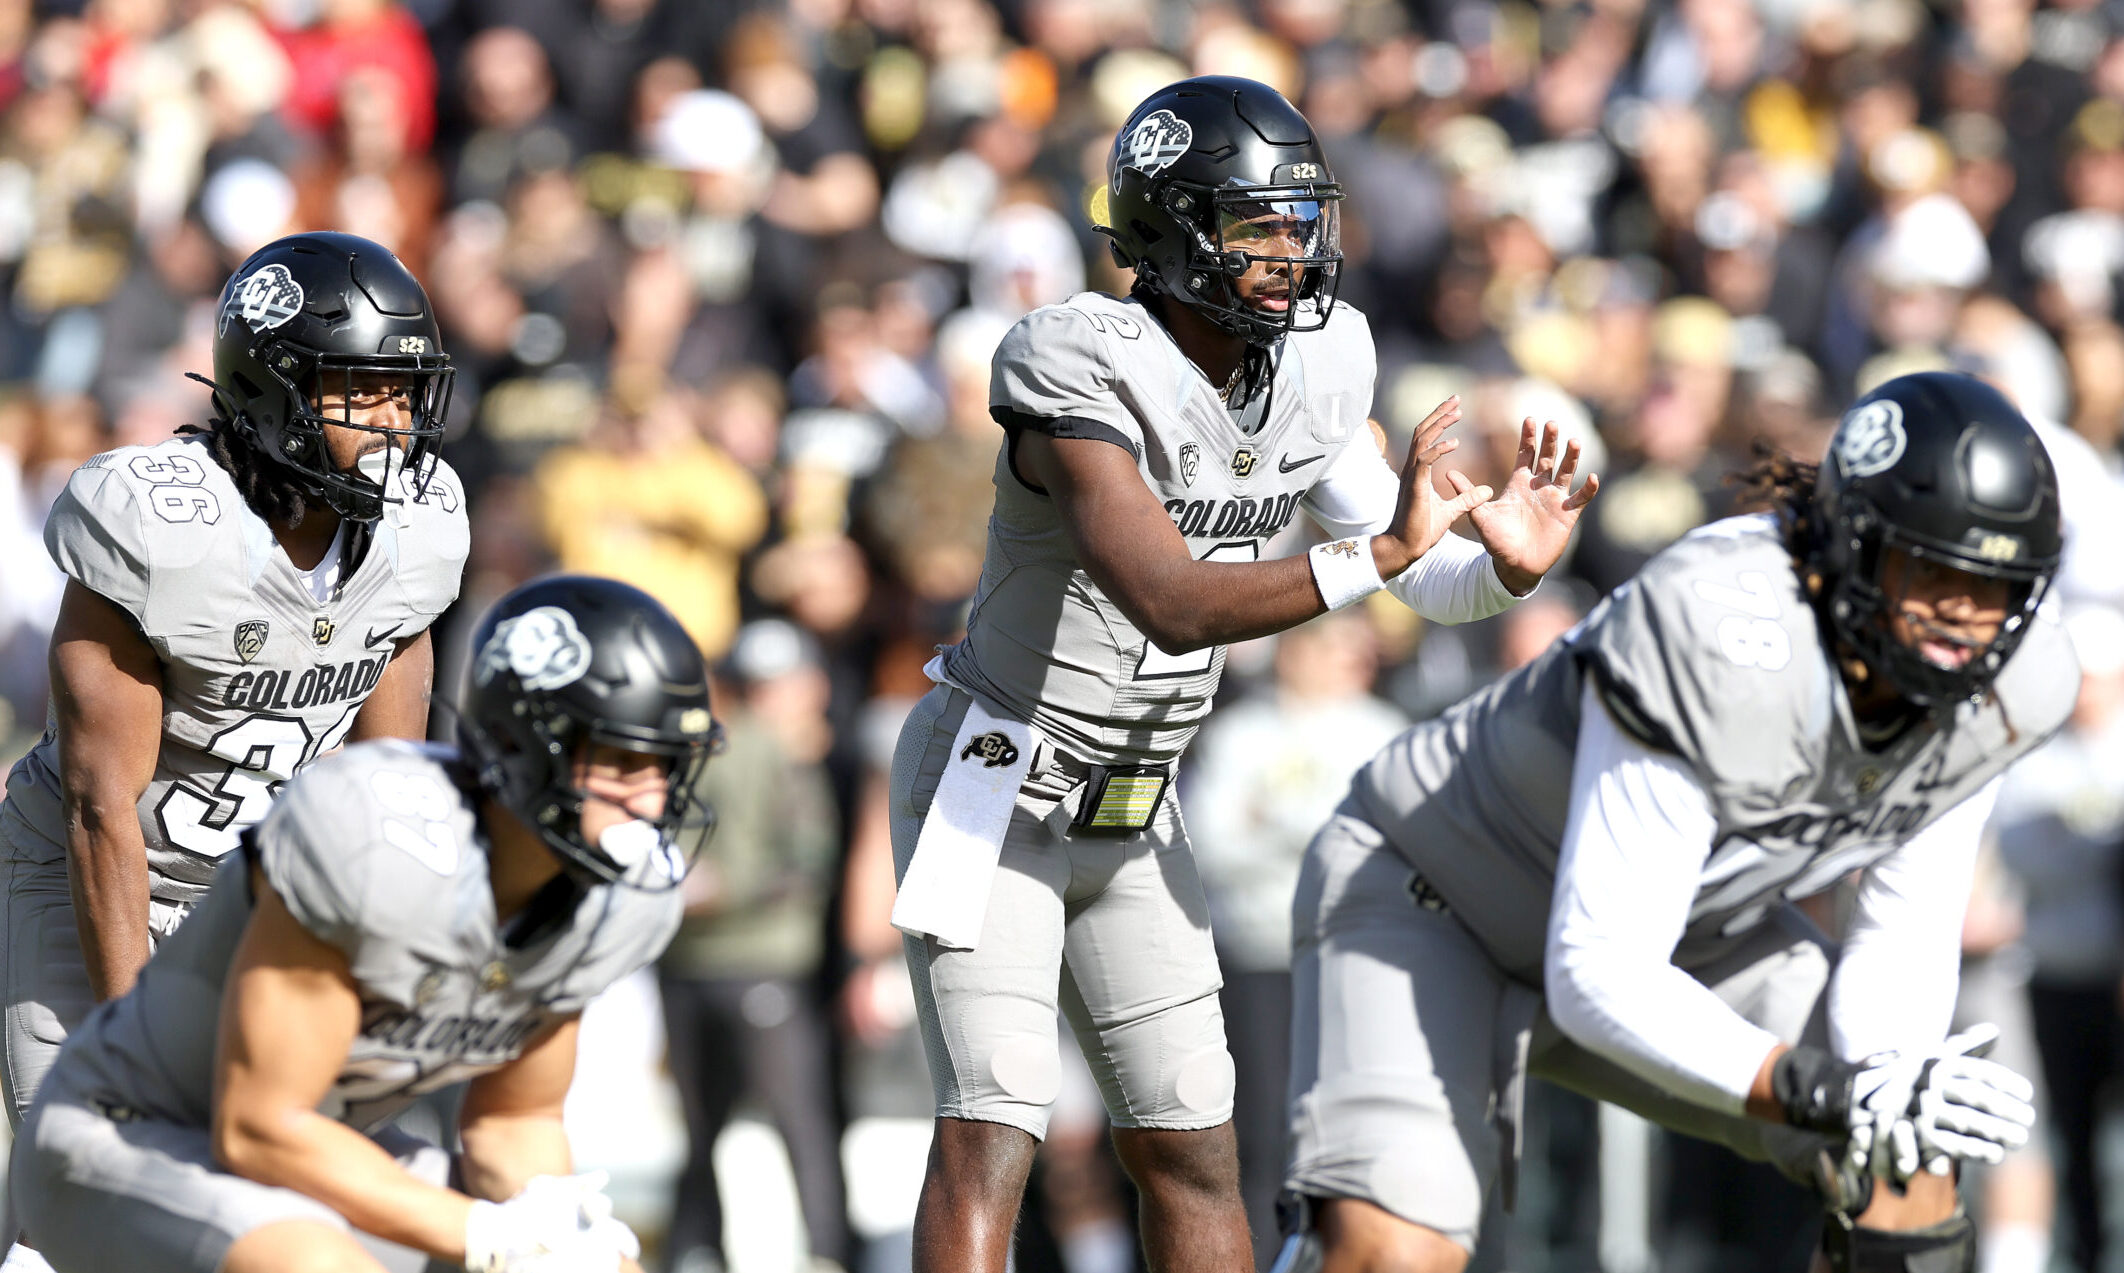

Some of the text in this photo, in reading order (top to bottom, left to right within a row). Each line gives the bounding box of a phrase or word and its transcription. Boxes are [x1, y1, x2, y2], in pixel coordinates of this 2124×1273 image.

[1231, 449, 1258, 477] CU
[128, 455, 221, 525] 36
[312, 616, 335, 645] CU
[241, 639, 259, 654] 12
[221, 653, 387, 710] COLORADO
[980, 734, 1007, 761] CU
